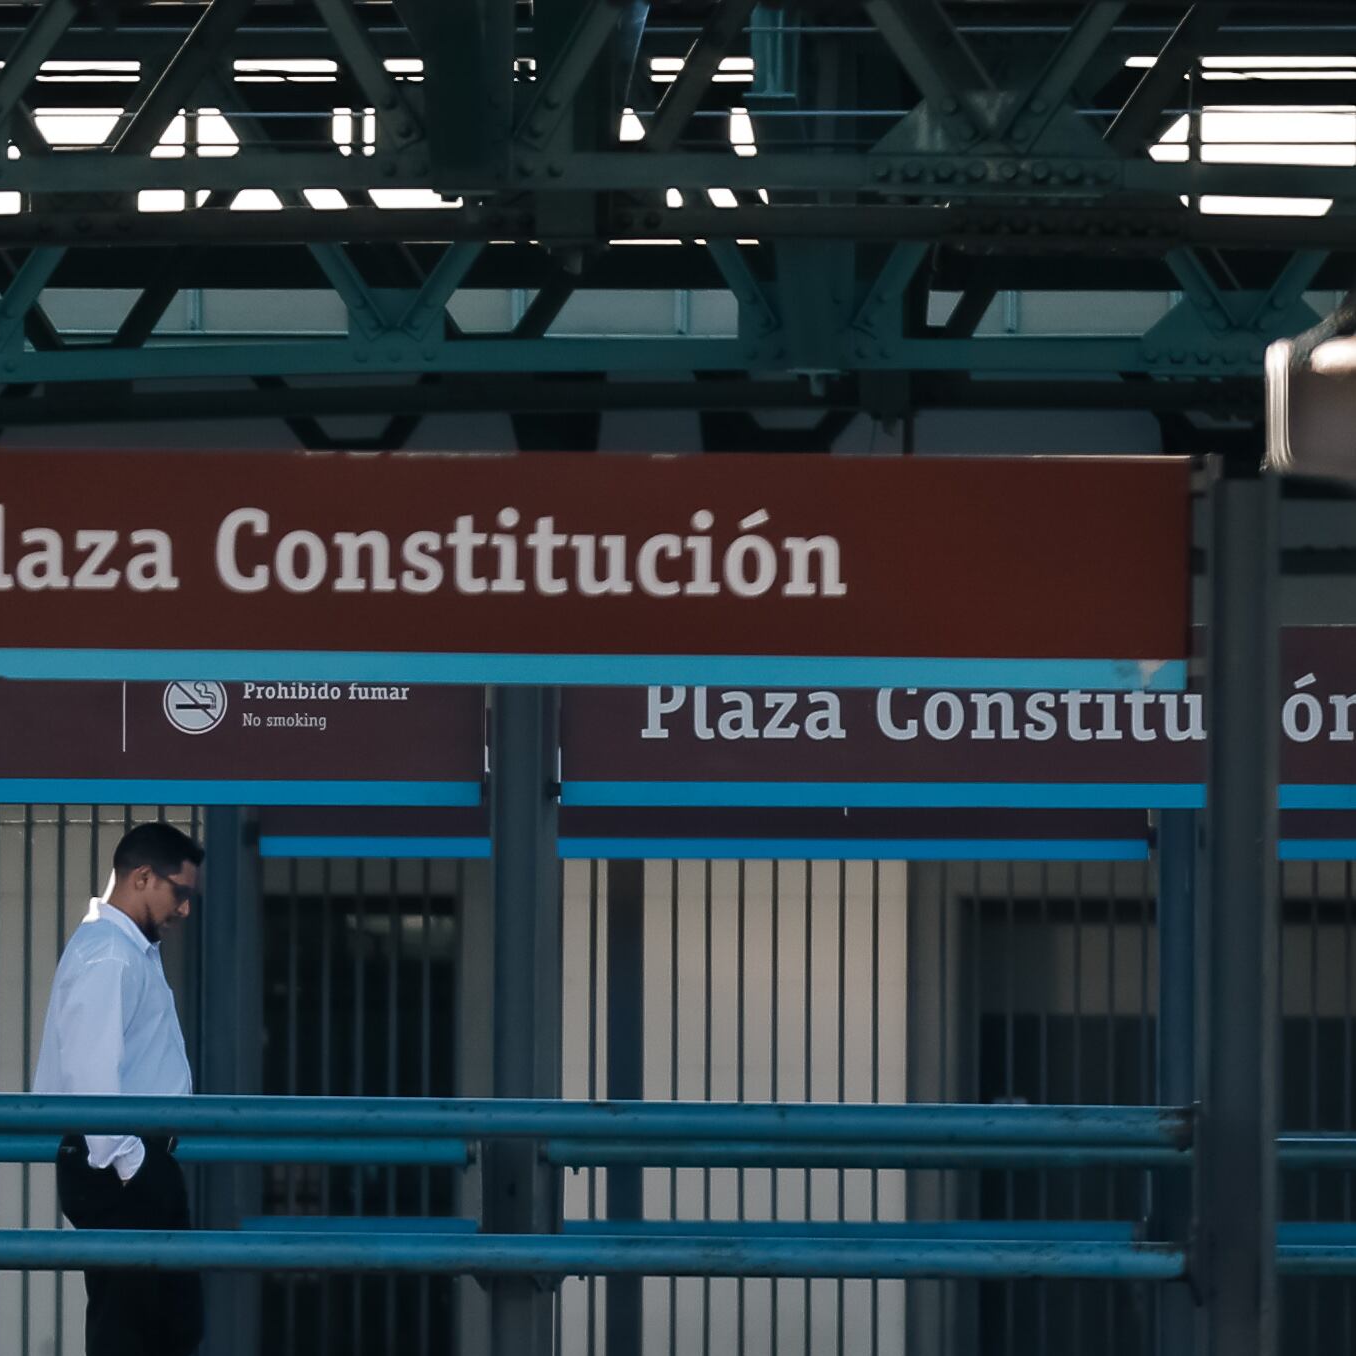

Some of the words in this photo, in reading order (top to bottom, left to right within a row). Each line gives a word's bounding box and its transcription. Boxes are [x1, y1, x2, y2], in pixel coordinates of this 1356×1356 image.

[215, 507, 848, 597] Constitución
[243, 682, 342, 700] Prohibido
[348, 682, 410, 700] fumar
[242, 712, 262, 727] No
[266, 712, 327, 731] smoking
[641, 686, 847, 740] Plaza
